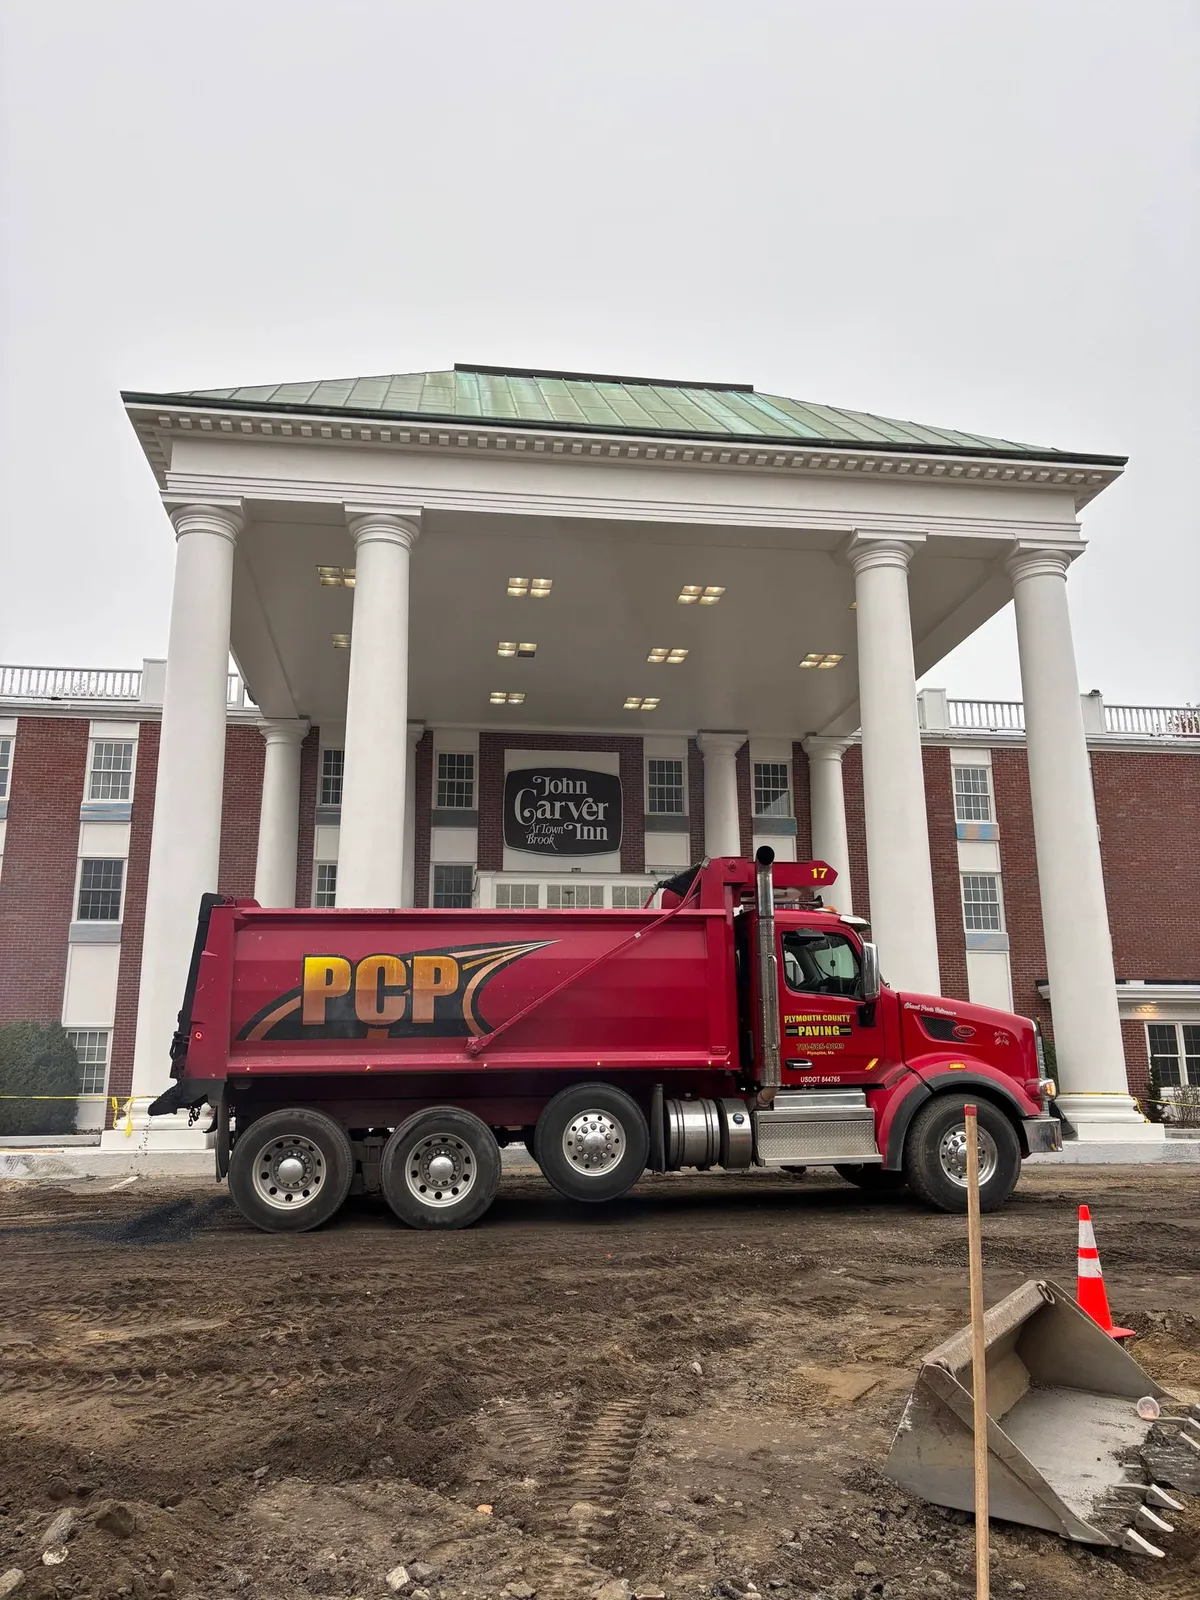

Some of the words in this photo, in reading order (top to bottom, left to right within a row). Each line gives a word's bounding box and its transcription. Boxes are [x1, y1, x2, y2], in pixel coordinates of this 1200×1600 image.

[532, 775, 588, 797] John
[514, 788, 609, 826] Carver
[525, 823, 539, 834] At
[540, 823, 564, 835] Town
[563, 821, 609, 841] Inn
[525, 834, 558, 850] Brook
[810, 867, 828, 879] 17
[302, 954, 460, 1026] PCP
[784, 1015, 821, 1023] PLYMOUTH
[822, 1015, 850, 1023] COUNTY
[798, 1025, 840, 1036] PAVING
